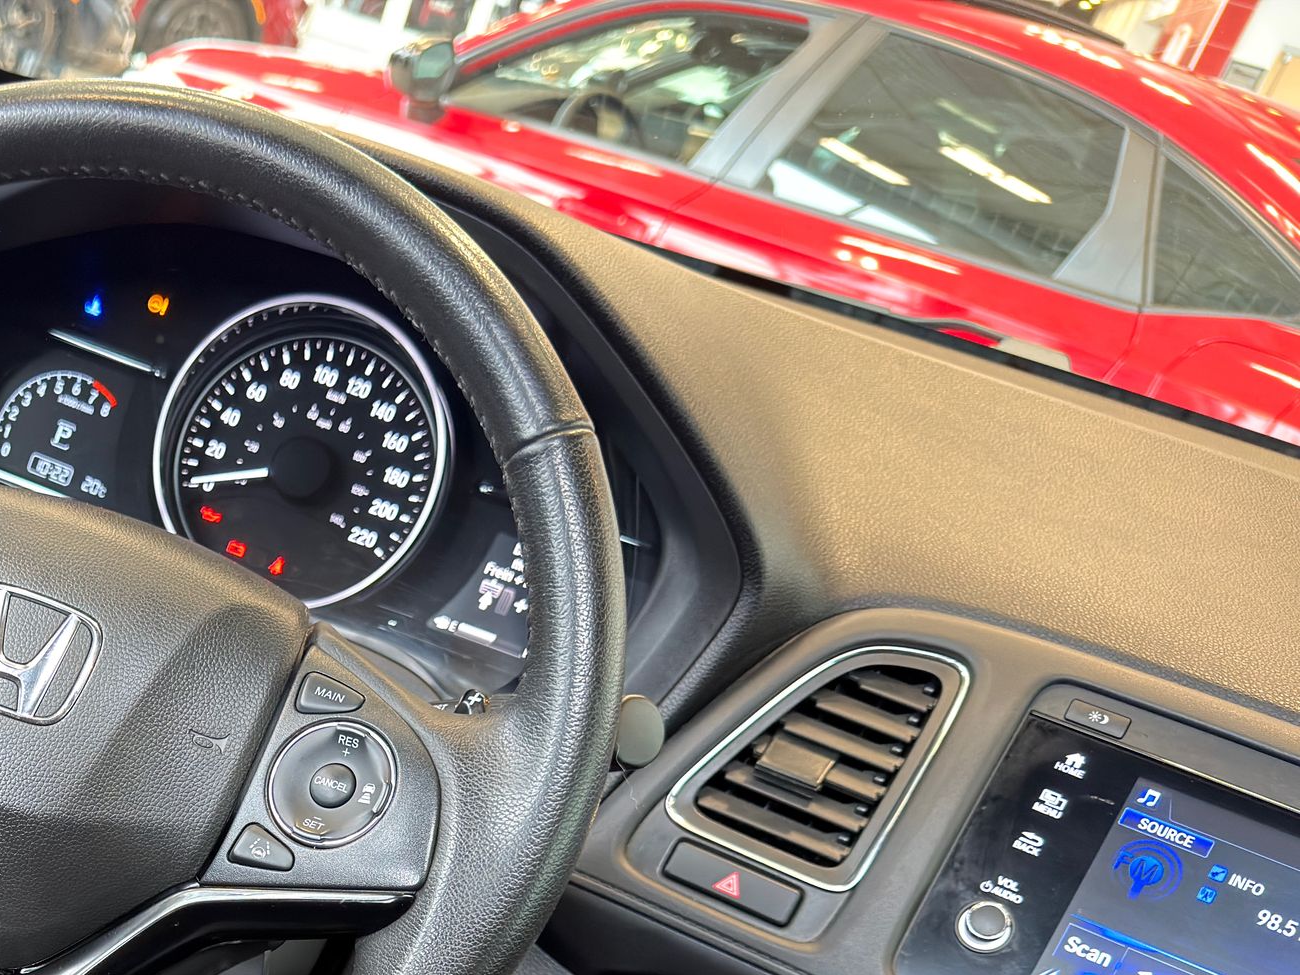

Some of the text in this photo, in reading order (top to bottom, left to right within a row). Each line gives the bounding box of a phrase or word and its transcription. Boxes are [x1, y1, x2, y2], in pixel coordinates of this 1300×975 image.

[279, 368, 300, 390] 80
[313, 364, 339, 388] 100
[37, 382, 47, 397] 4
[54, 380, 64, 394] 5
[72, 382, 81, 396] 6
[88, 388, 99, 404] 7
[246, 381, 267, 402] 60
[345, 375, 372, 399] 120
[21, 391, 32, 407] 3
[8, 405, 19, 421] 2
[100, 402, 111, 417] 8
[220, 406, 241, 427] 40
[370, 399, 397, 423] 140
[4, 424, 11, 438] 1
[54, 424, 74, 444] P
[1, 442, 11, 457] 0
[205, 439, 226, 459] 20
[382, 430, 409, 453] 160
[36, 459, 70, 483] 10:22
[383, 465, 410, 488] 180
[368, 498, 399, 521] 200
[347, 525, 378, 548] 220
[314, 686, 346, 704] MAIN
[337, 734, 360, 749] RES
[1054, 761, 1087, 779] HOME
[314, 775, 348, 794] CANCEL
[1032, 801, 1064, 820] MENU
[302, 818, 325, 831] SET
[1137, 817, 1196, 849] SOURCE
[1012, 839, 1043, 857] BACK
[998, 875, 1020, 893] VOL
[1227, 873, 1266, 897] INFO
[991, 886, 1024, 905] AUDIO
[1256, 909, 1300, 938] 98.5
[1063, 935, 1113, 968] Scan
